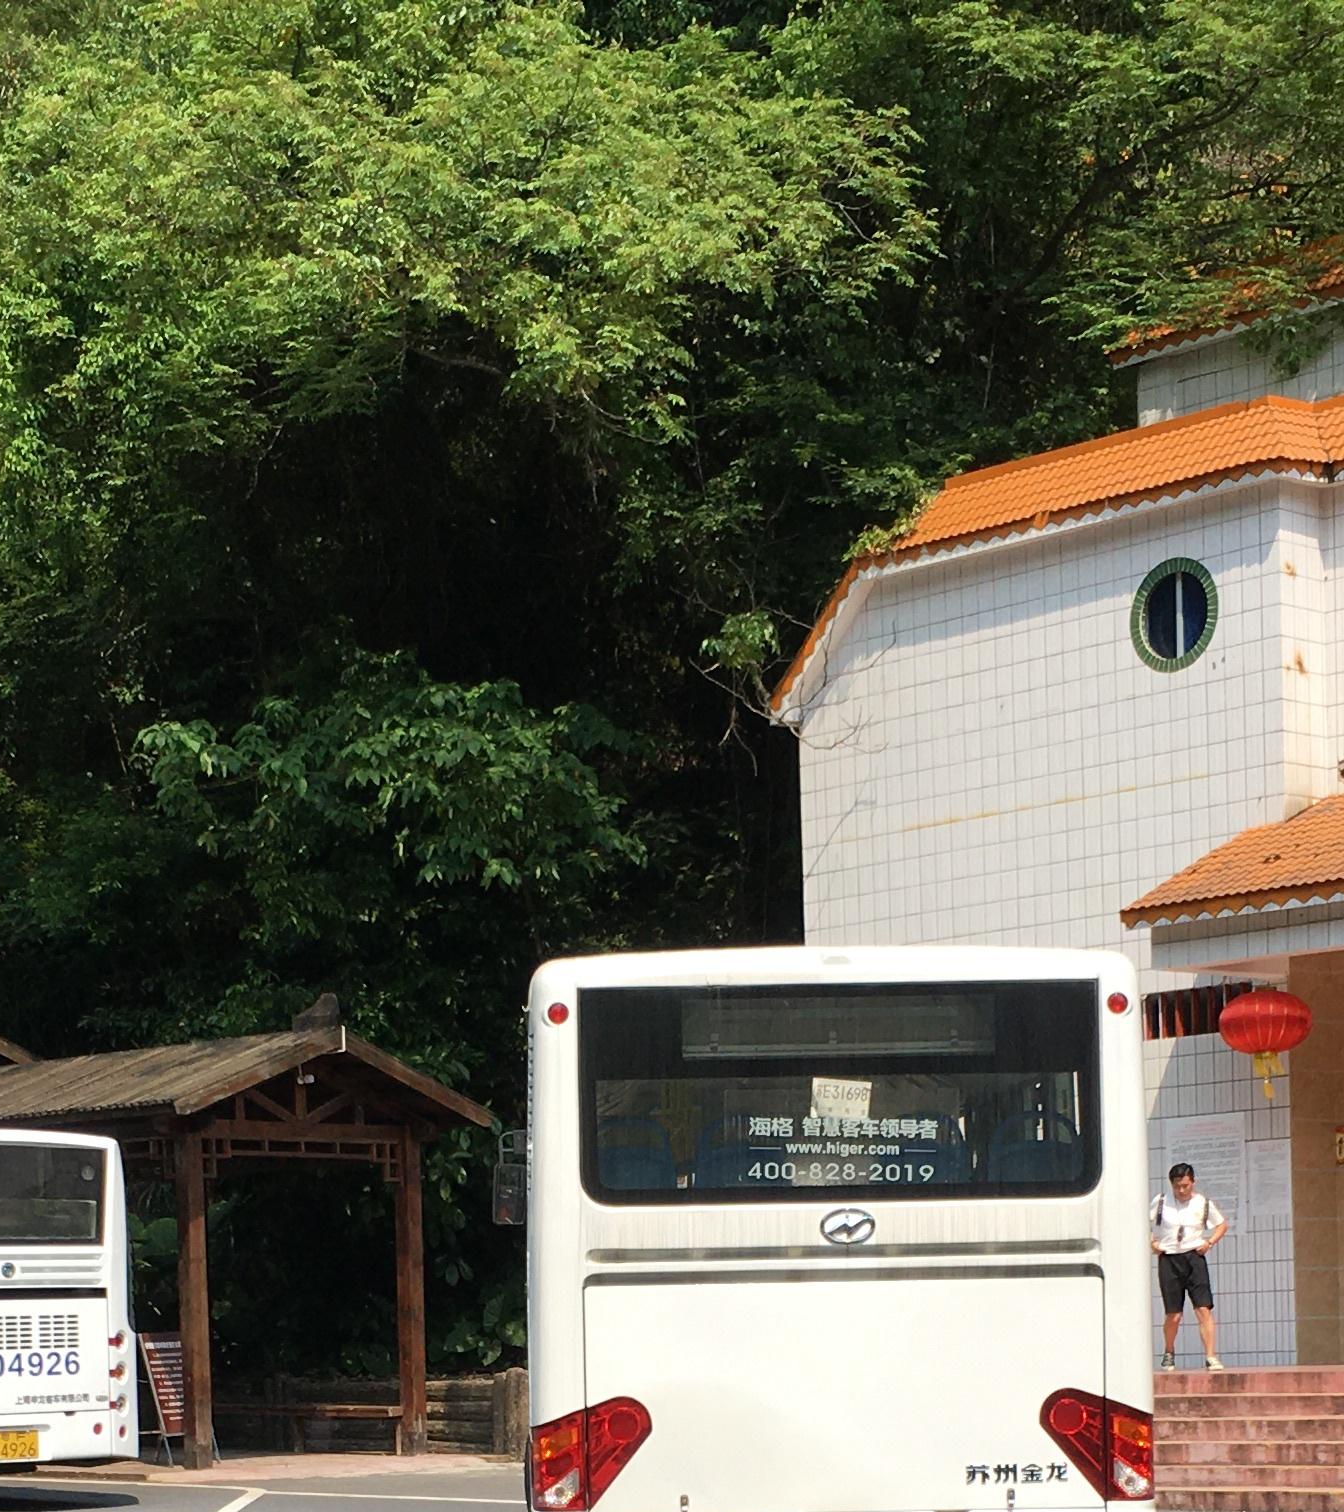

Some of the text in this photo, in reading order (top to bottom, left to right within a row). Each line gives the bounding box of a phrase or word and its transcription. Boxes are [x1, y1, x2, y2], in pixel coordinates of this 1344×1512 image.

[749, 1117, 938, 1139] 海格 智慧客车领导者
[786, 1142, 899, 1157] www.higer.com
[748, 1162, 934, 1182] 400-828-2019
[965, 1462, 1069, 1485] 苏州金龙
